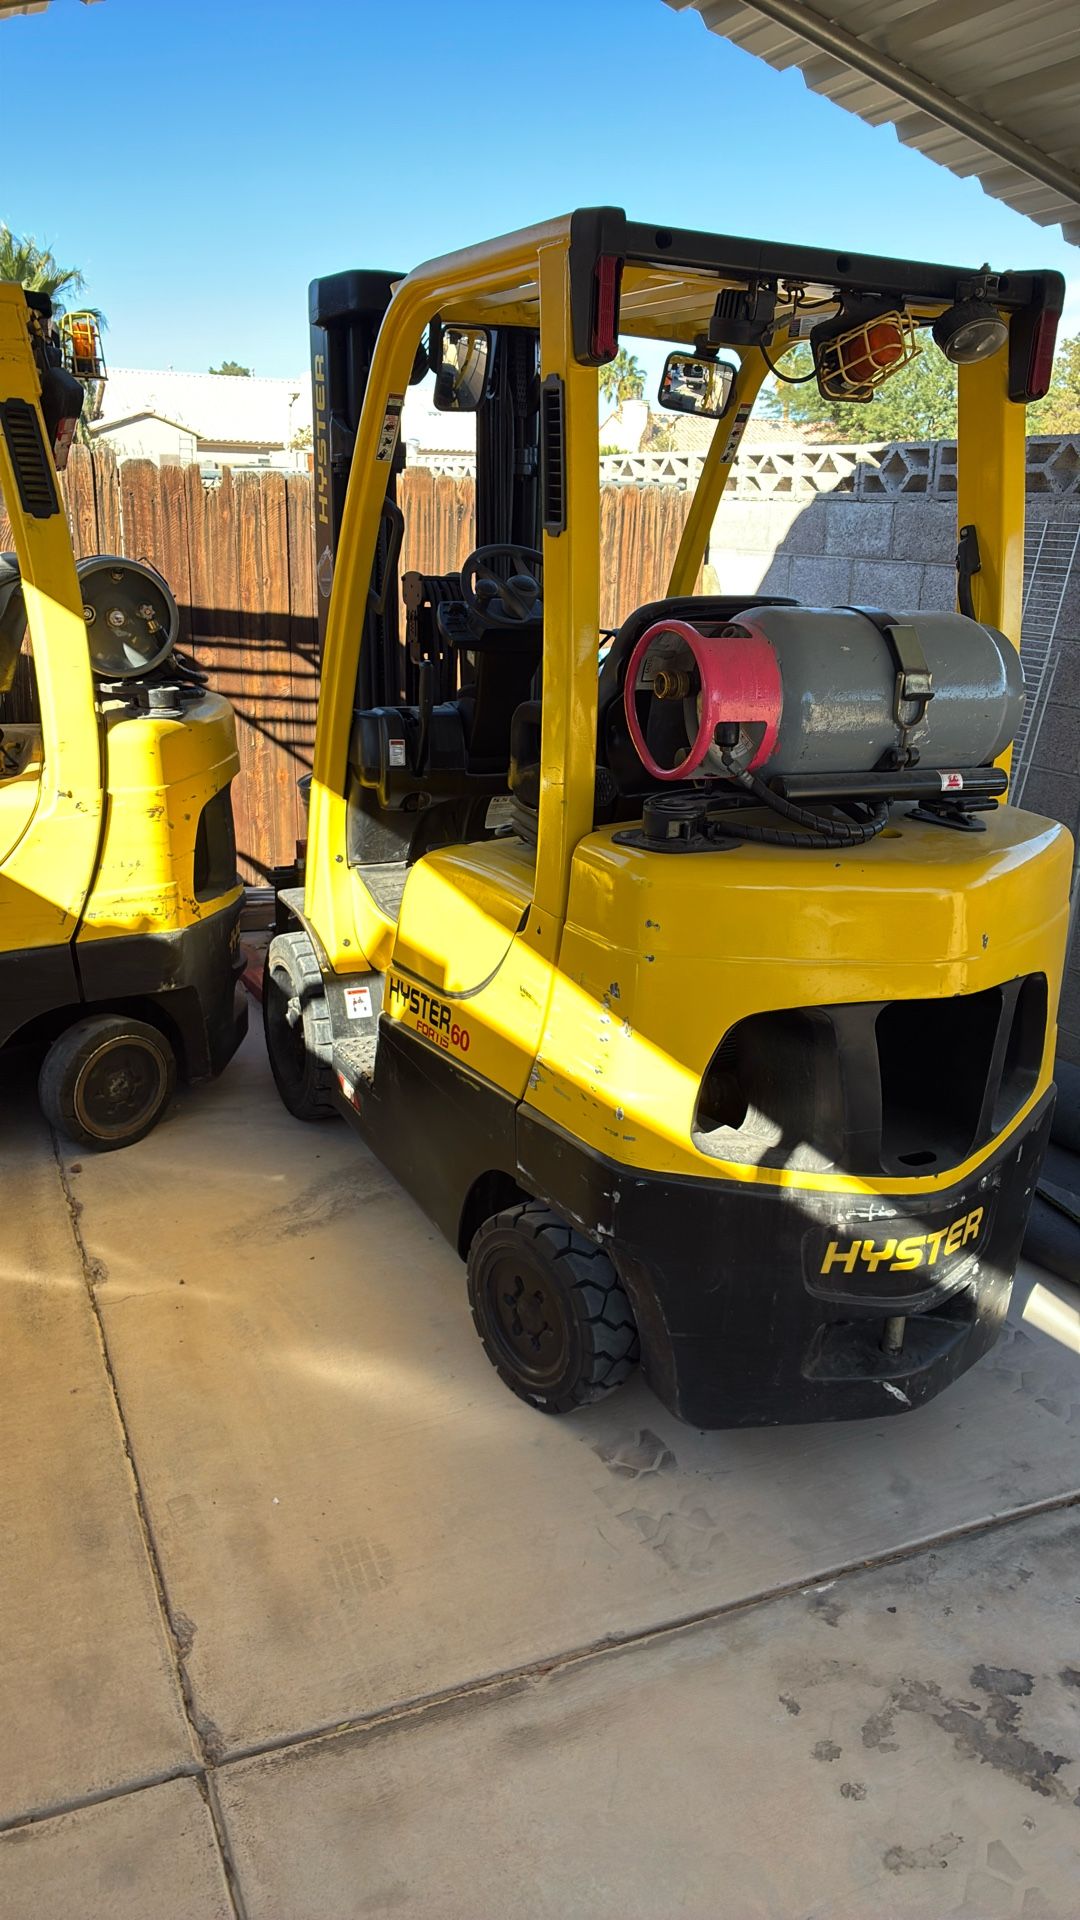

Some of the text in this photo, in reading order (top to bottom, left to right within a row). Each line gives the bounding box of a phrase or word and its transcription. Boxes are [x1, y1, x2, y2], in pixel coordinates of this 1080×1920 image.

[314, 354, 329, 524] HYSTER
[389, 977, 470, 1052] HYSTER 60
[819, 1206, 984, 1275] HYSTER
